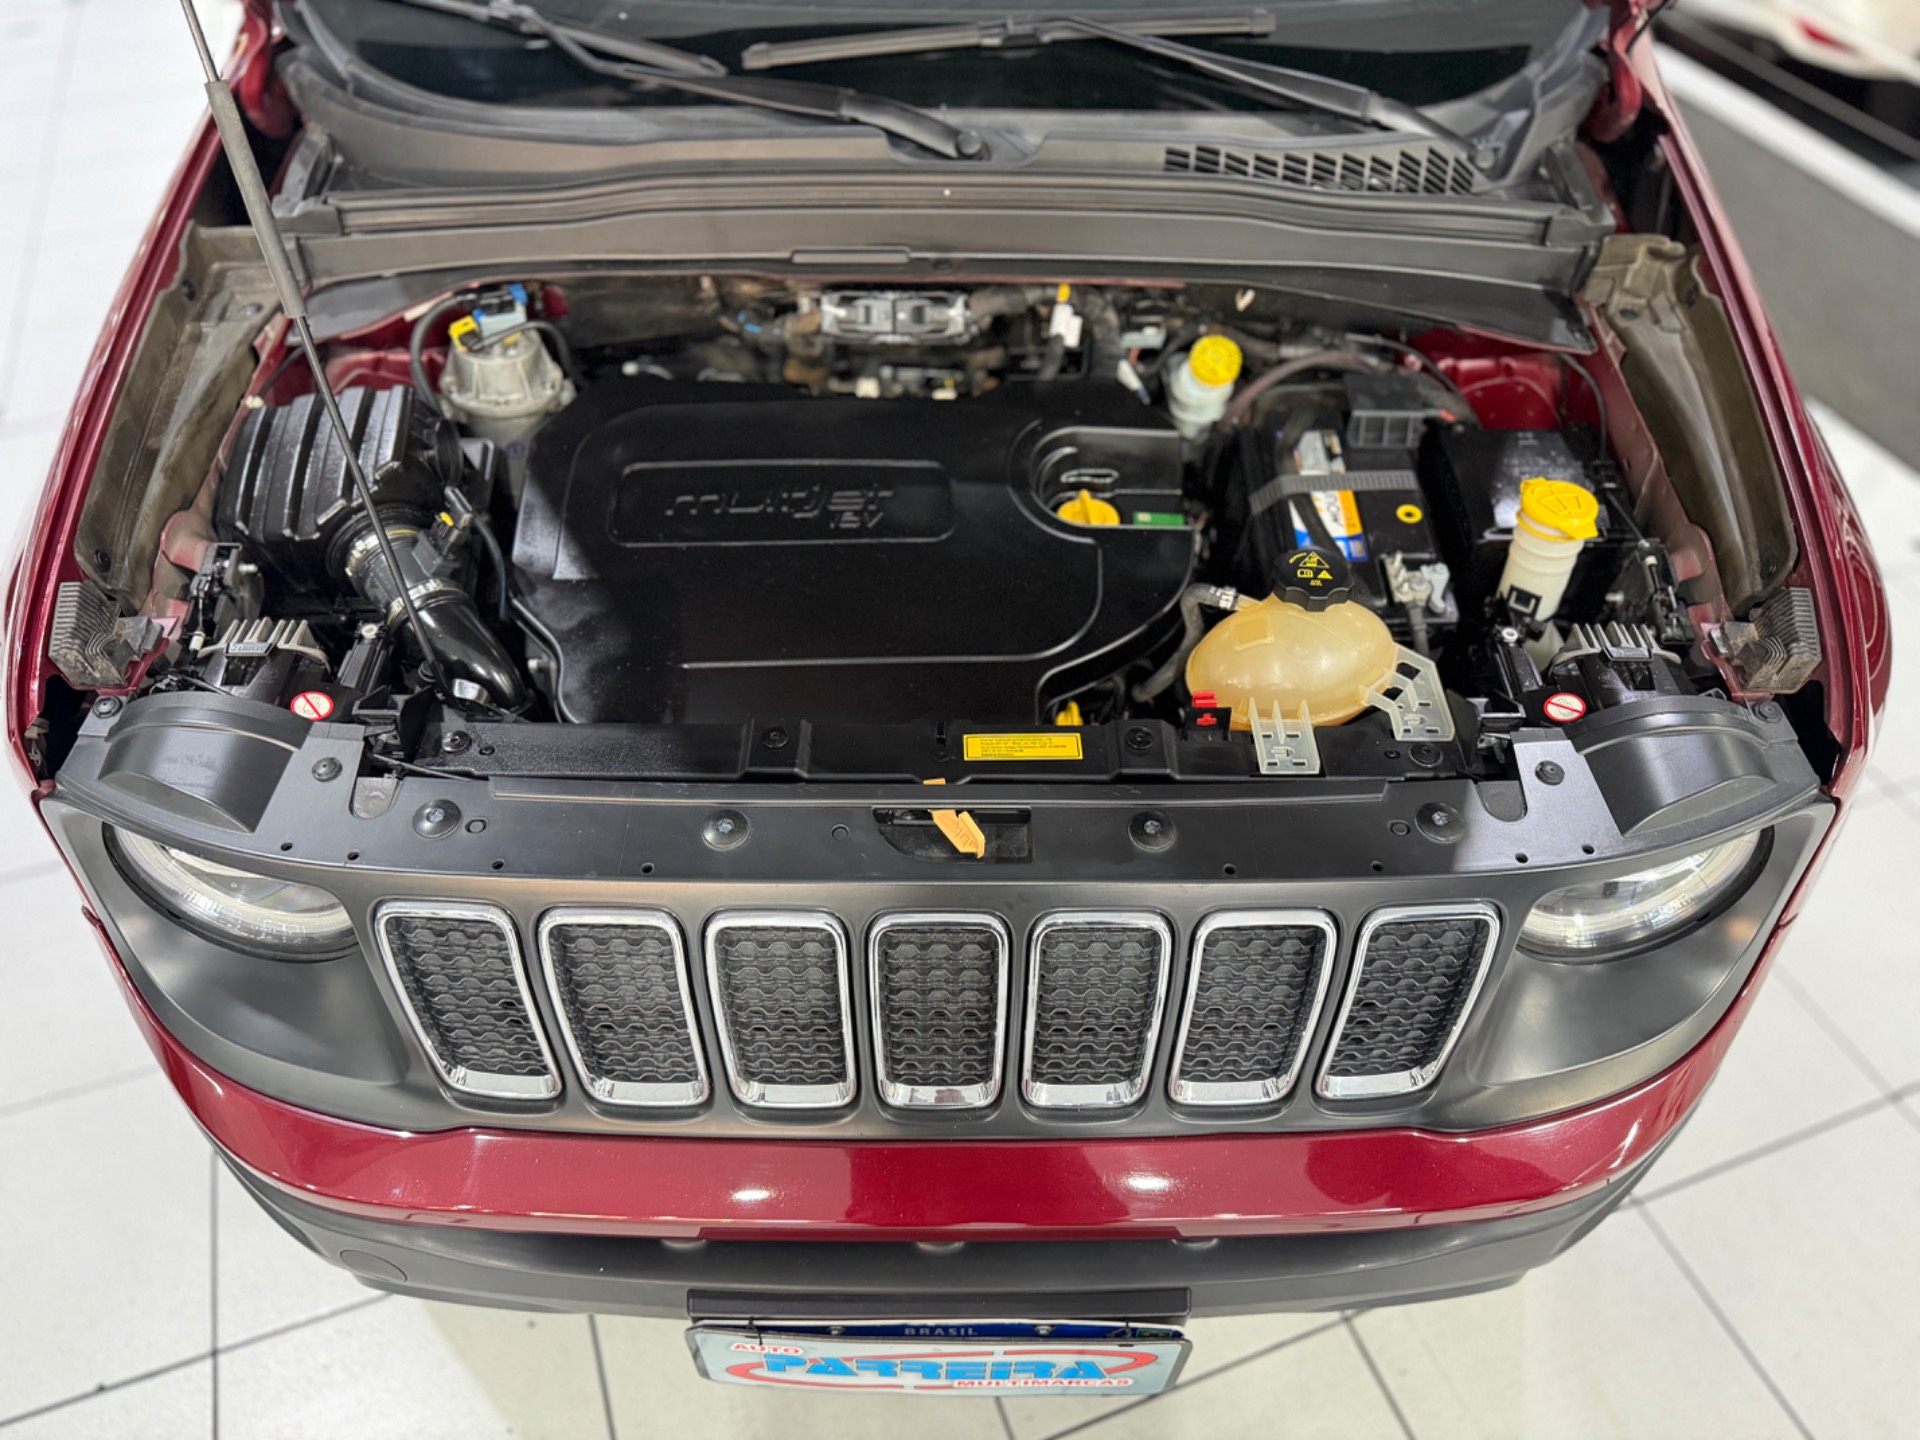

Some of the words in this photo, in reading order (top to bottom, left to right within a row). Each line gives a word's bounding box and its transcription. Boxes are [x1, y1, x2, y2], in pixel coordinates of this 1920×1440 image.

[904, 1326, 978, 1337] BRASIL
[732, 1342, 801, 1356] AUTO
[765, 1353, 1107, 1381] PARREIRA
[956, 1377, 1131, 1388] MULTIMARCAS
